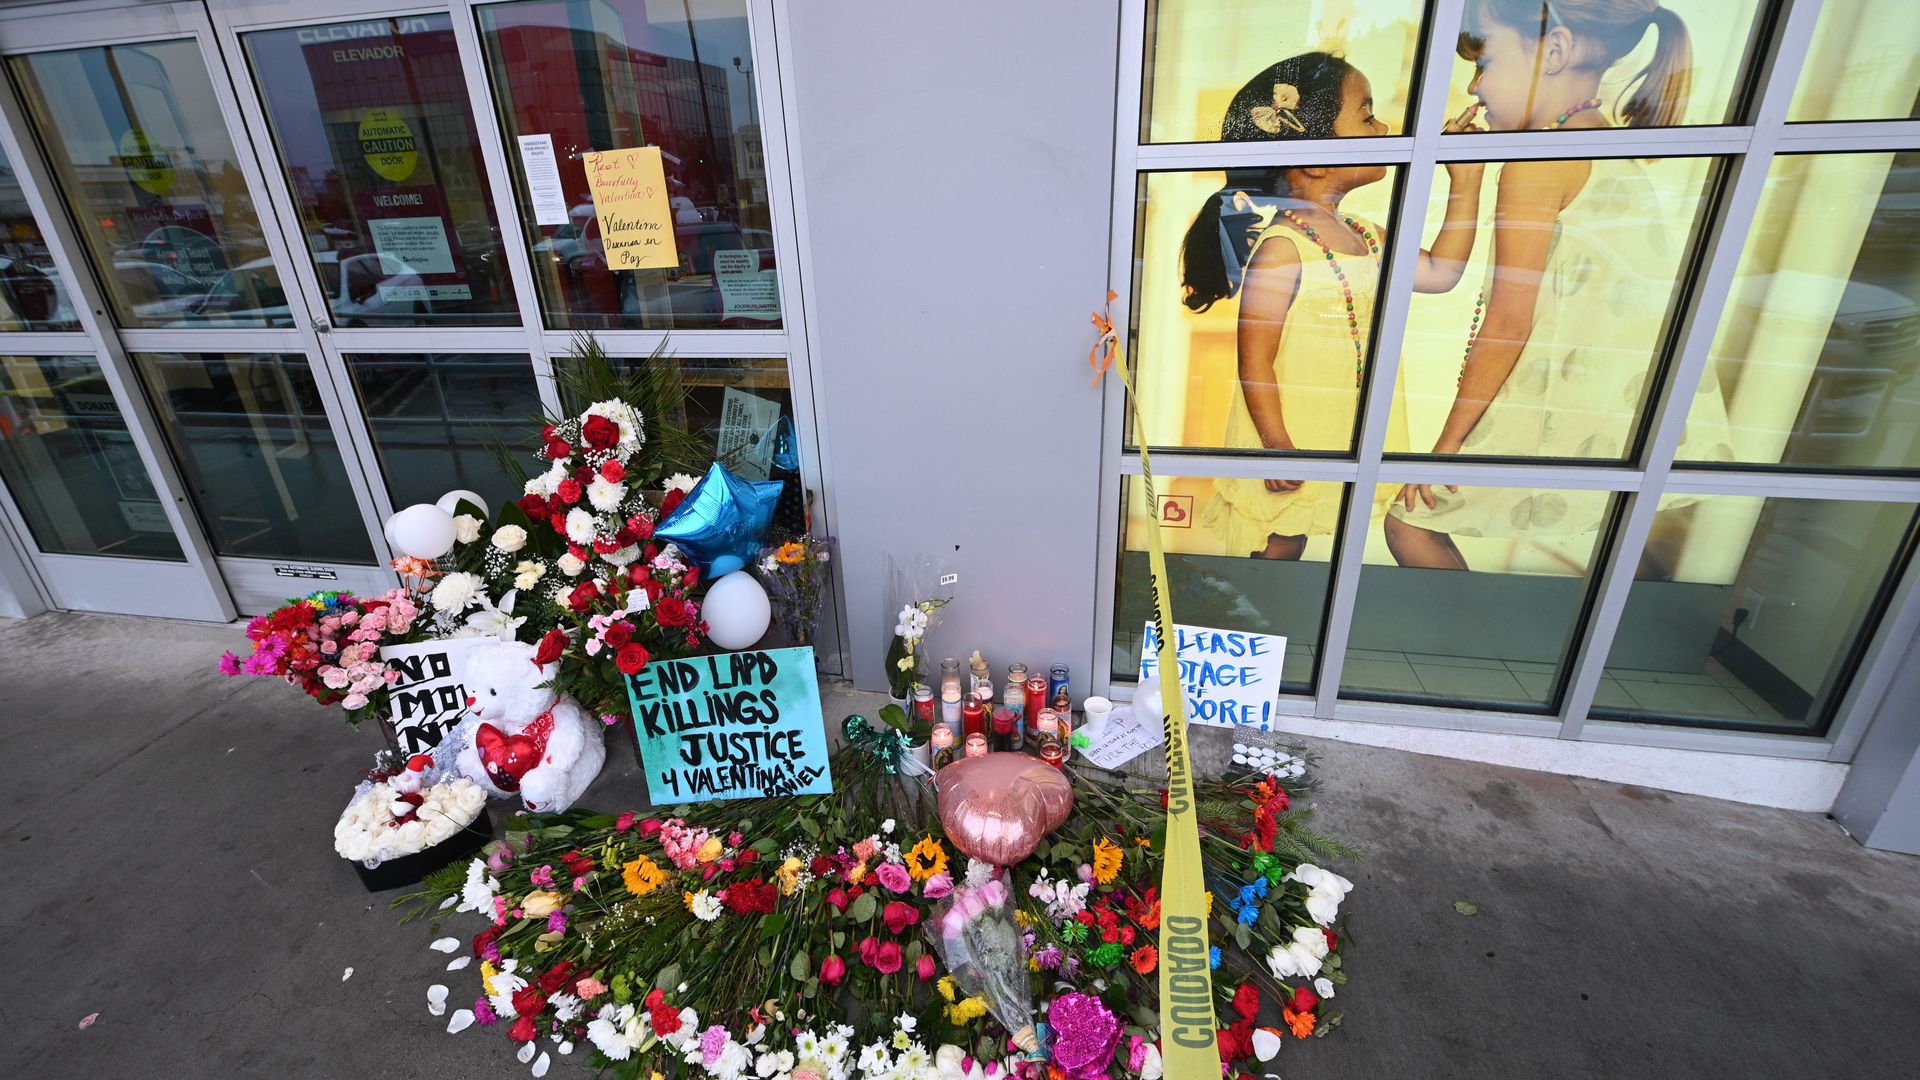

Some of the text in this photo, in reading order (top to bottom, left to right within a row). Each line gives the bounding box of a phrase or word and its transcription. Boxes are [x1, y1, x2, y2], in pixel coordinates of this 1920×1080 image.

[333, 46, 405, 63] ELEVADOR
[362, 126, 406, 138] AUTOMATIC
[362, 139, 414, 153] CAUTION
[380, 157, 404, 166] DOOR
[373, 194, 424, 207] WELCOME!
[602, 213, 662, 234] Valentina
[620, 251, 651, 267] Paz
[1145, 626, 1272, 657] RLEASE
[385, 652, 452, 686] NO
[631, 651, 778, 701] END LAPD
[661, 768, 680, 797] 4
